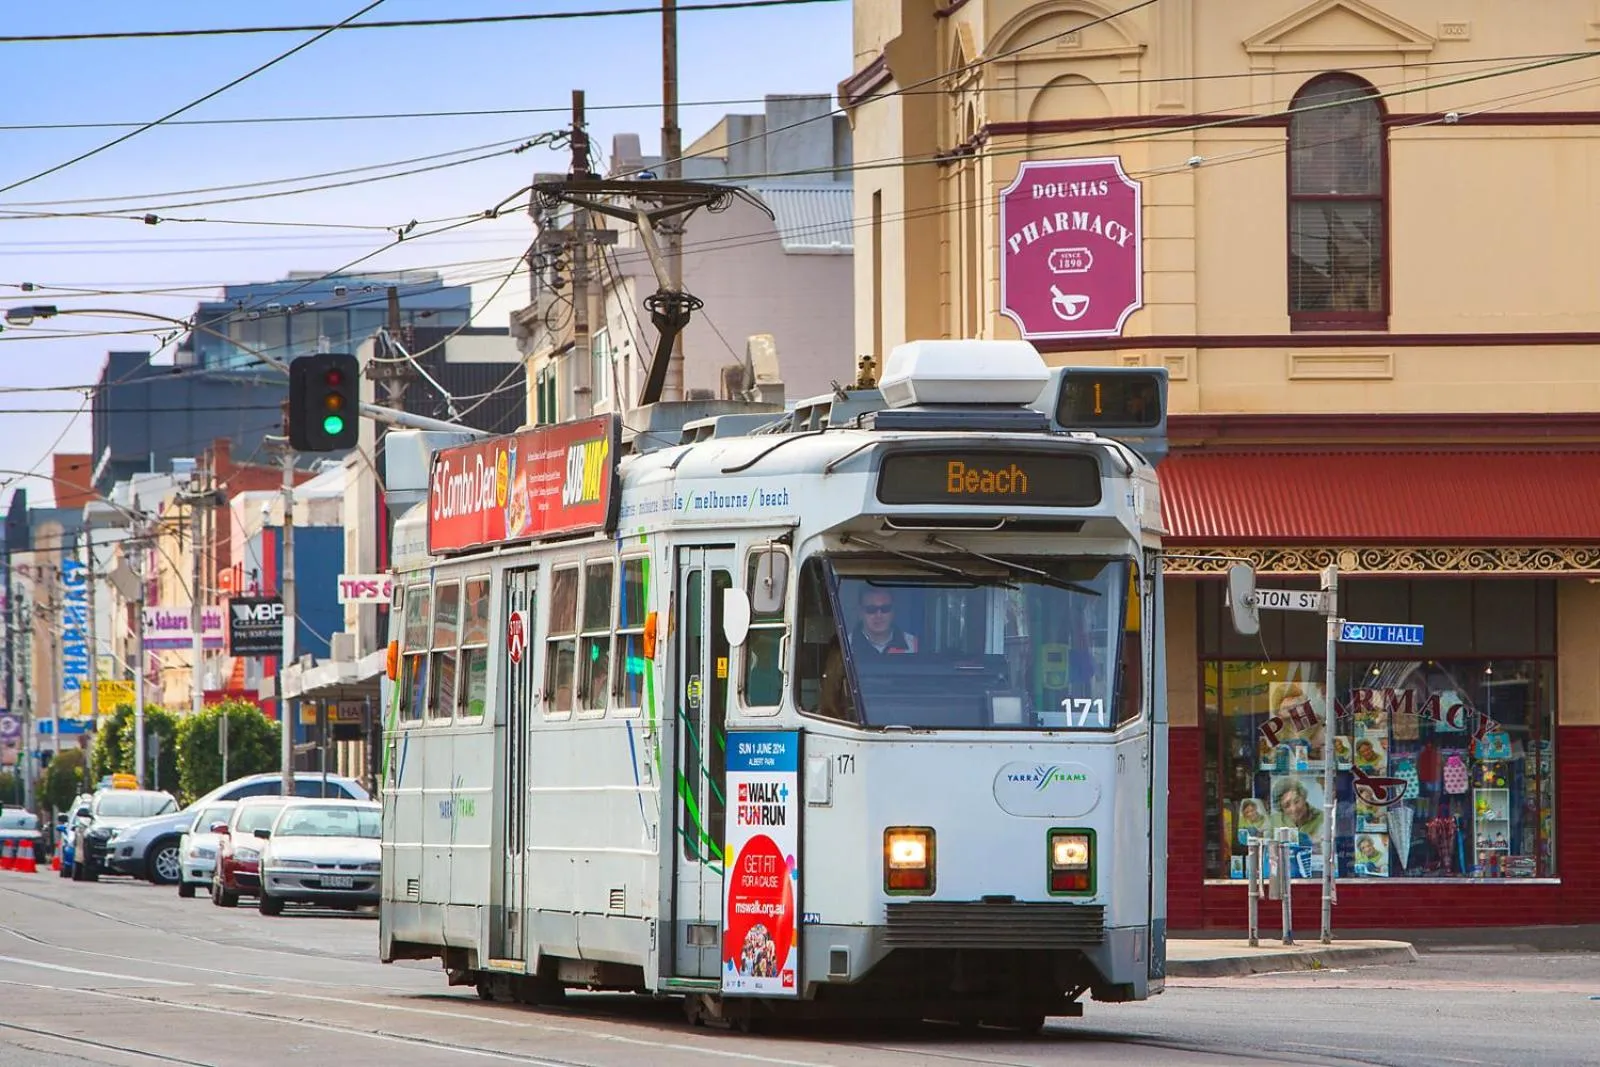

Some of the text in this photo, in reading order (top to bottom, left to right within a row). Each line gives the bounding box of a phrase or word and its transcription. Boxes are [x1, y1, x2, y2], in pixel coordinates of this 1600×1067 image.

[1032, 180, 1108, 199] DOUNIAS
[1007, 211, 1133, 255] PHARMACY
[1093, 383, 1102, 416] 1
[563, 436, 609, 507] SUBWAY
[947, 461, 1028, 494] Beach
[442, 455, 473, 519] Combo
[474, 448, 499, 512] Deal
[694, 490, 747, 509] melbourne
[760, 488, 789, 506] beach
[340, 580, 379, 598] TIPS
[1255, 591, 1290, 607] STON
[1344, 625, 1420, 642] SOUT HALL
[1061, 698, 1104, 727] 171
[739, 742, 751, 755] SUN
[757, 743, 772, 755] JUNE
[837, 754, 855, 775] 171
[748, 783, 779, 803] WALK
[744, 854, 776, 873] GET FIT
[741, 875, 754, 888] FOR
[759, 875, 779, 888] CAUSE
[735, 901, 785, 917] mswalk.org.au
[804, 914, 819, 923] APN
